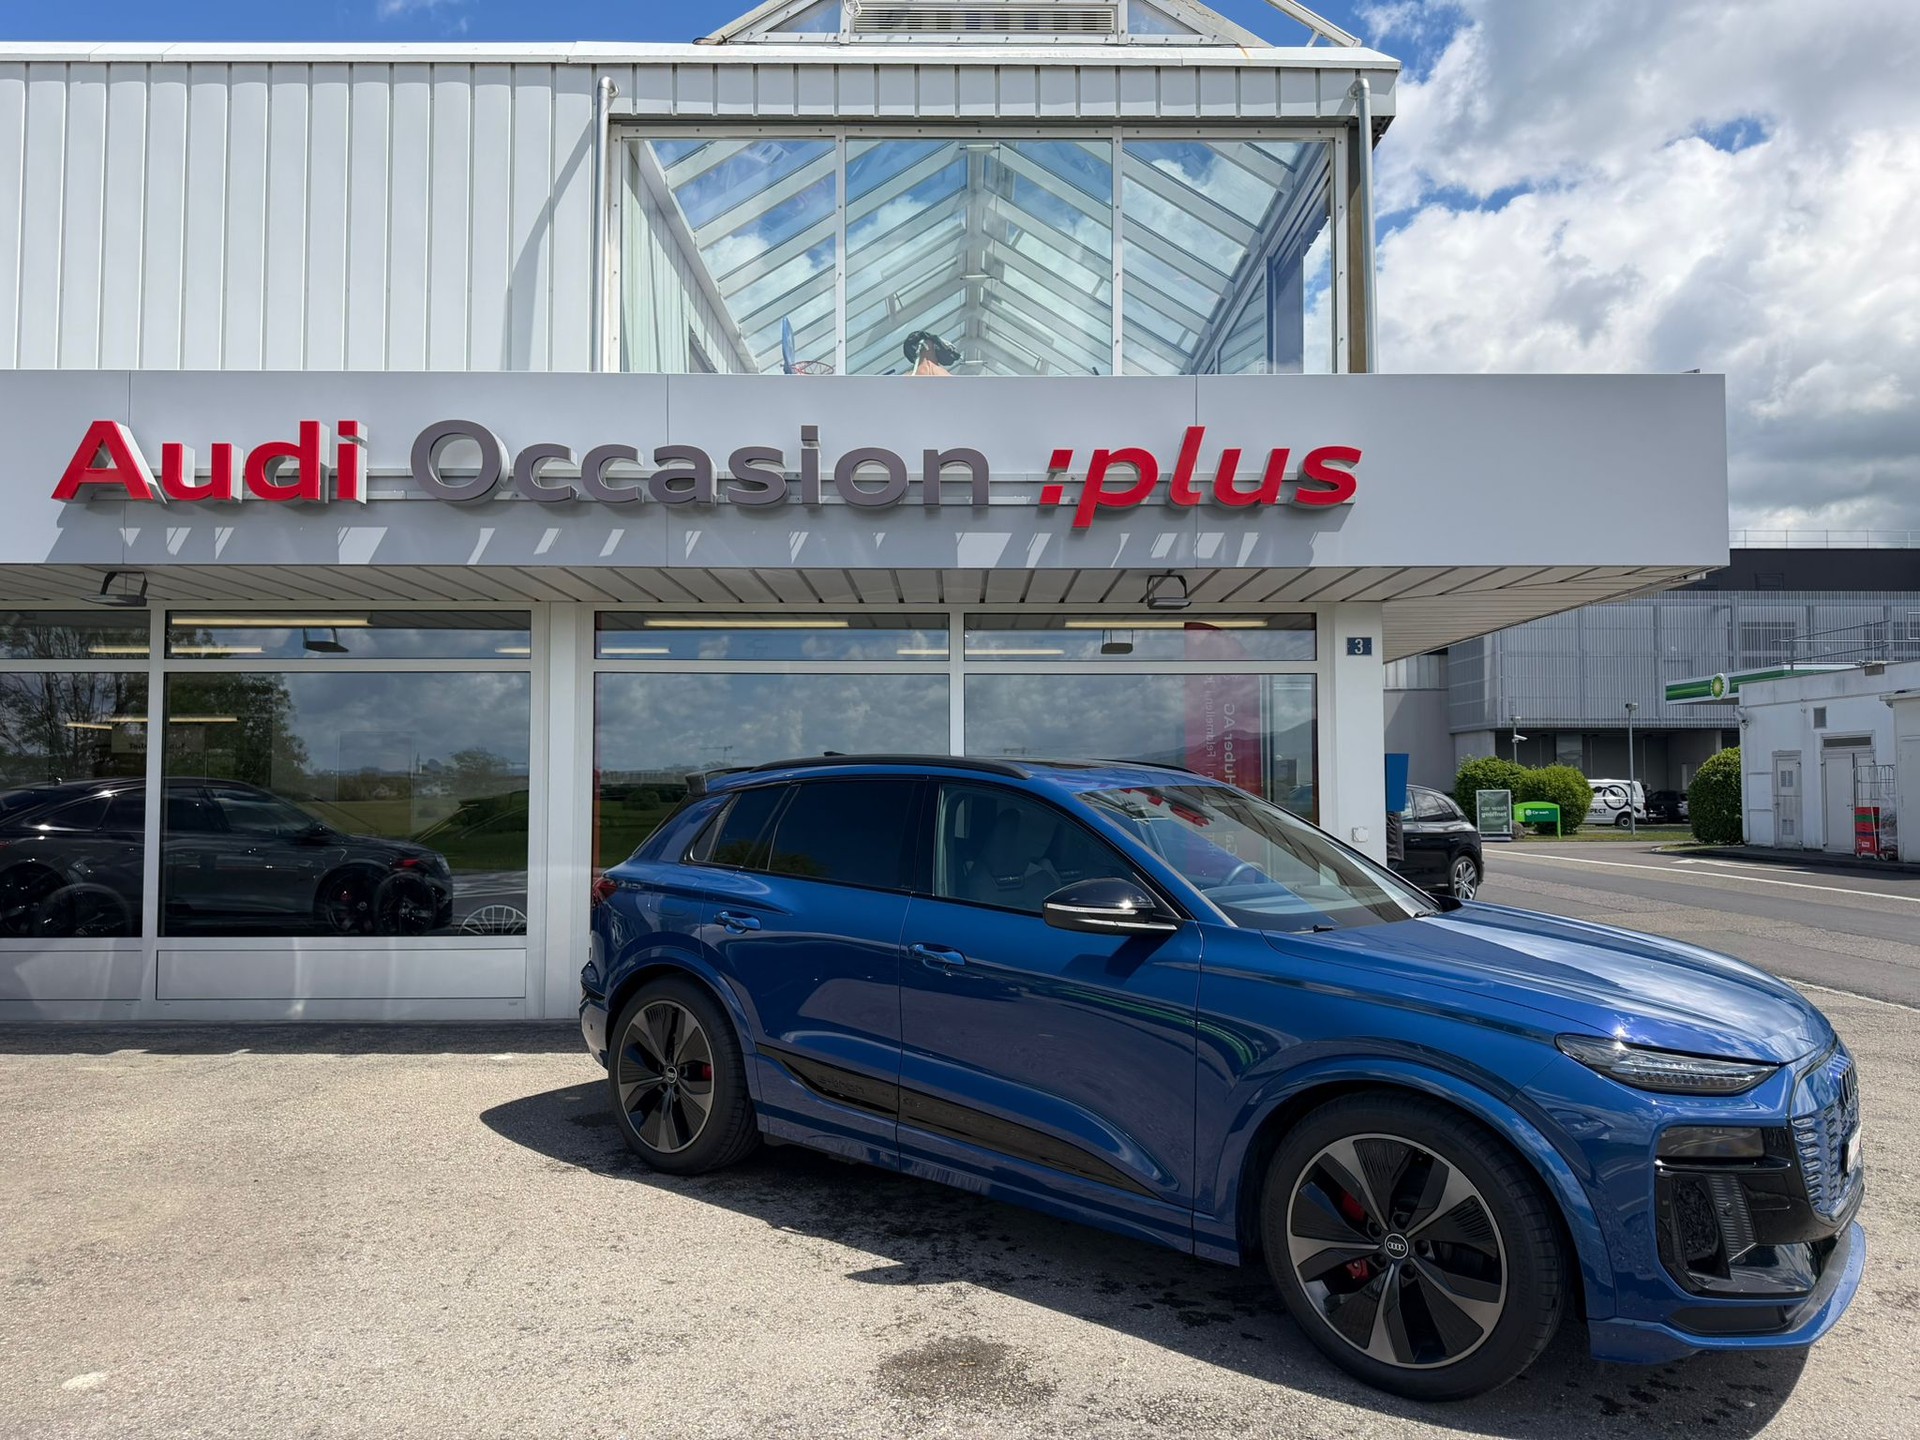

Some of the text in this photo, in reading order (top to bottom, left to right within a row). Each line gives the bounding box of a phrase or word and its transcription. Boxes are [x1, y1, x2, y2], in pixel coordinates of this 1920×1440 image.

[51, 419, 366, 502] Audi
[410, 419, 990, 504] Occasion
[1354, 638, 1364, 654] 3
